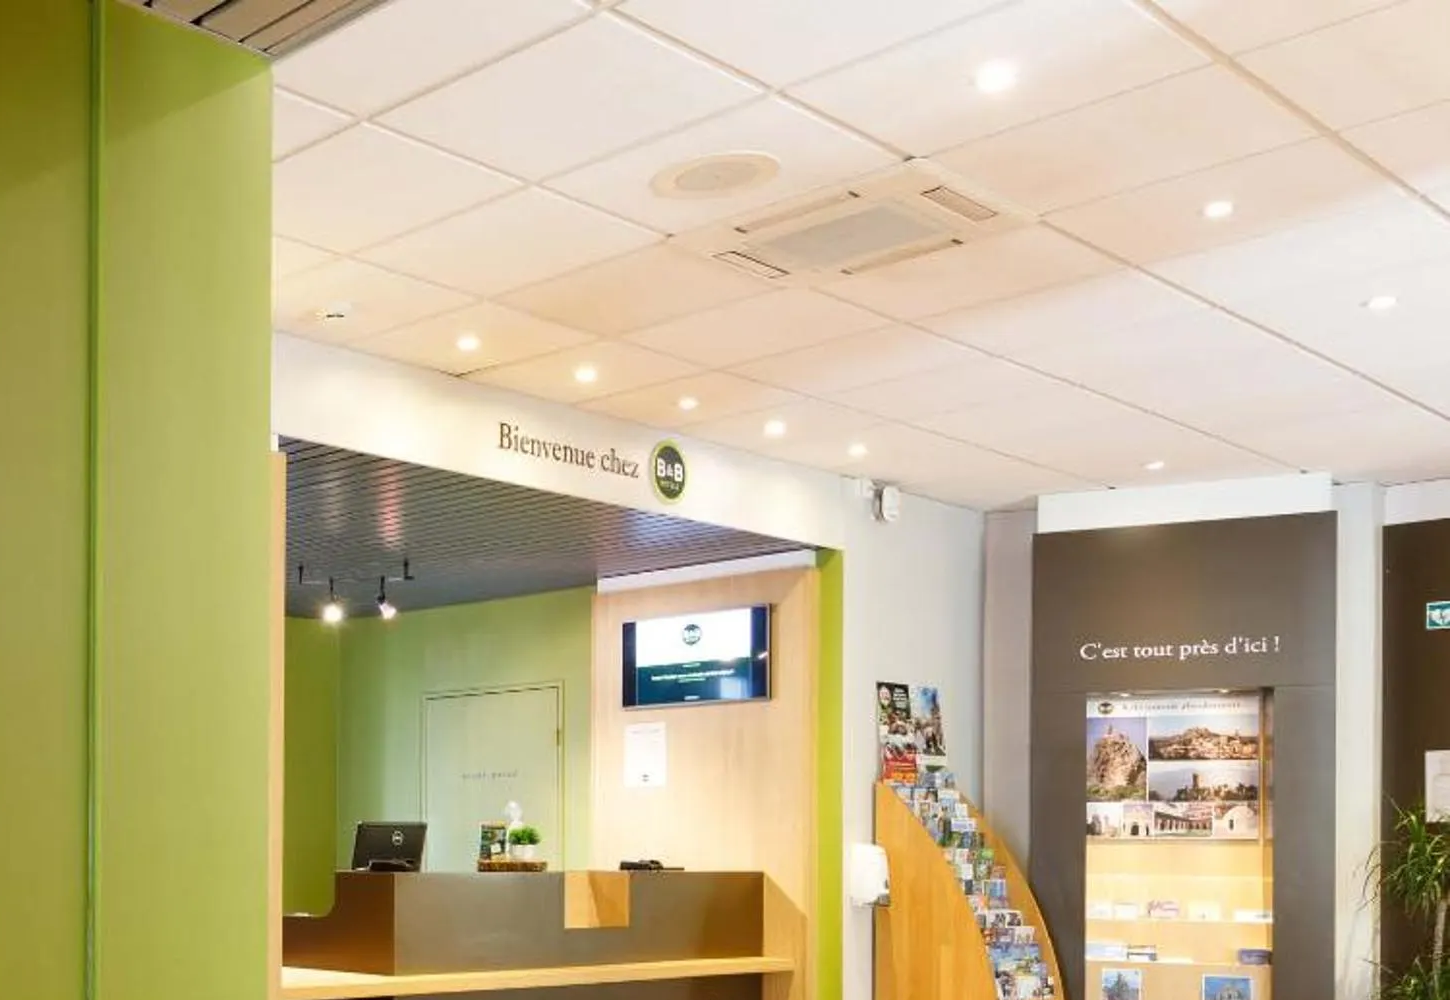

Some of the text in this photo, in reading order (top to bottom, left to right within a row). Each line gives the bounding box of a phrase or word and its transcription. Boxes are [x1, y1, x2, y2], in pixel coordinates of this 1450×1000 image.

[498, 421, 640, 479] Bienvenue chez
[1079, 642, 1128, 661] C'est
[1133, 645, 1174, 659] tout
[1179, 639, 1219, 661] près
[1224, 636, 1268, 655] d'ici
